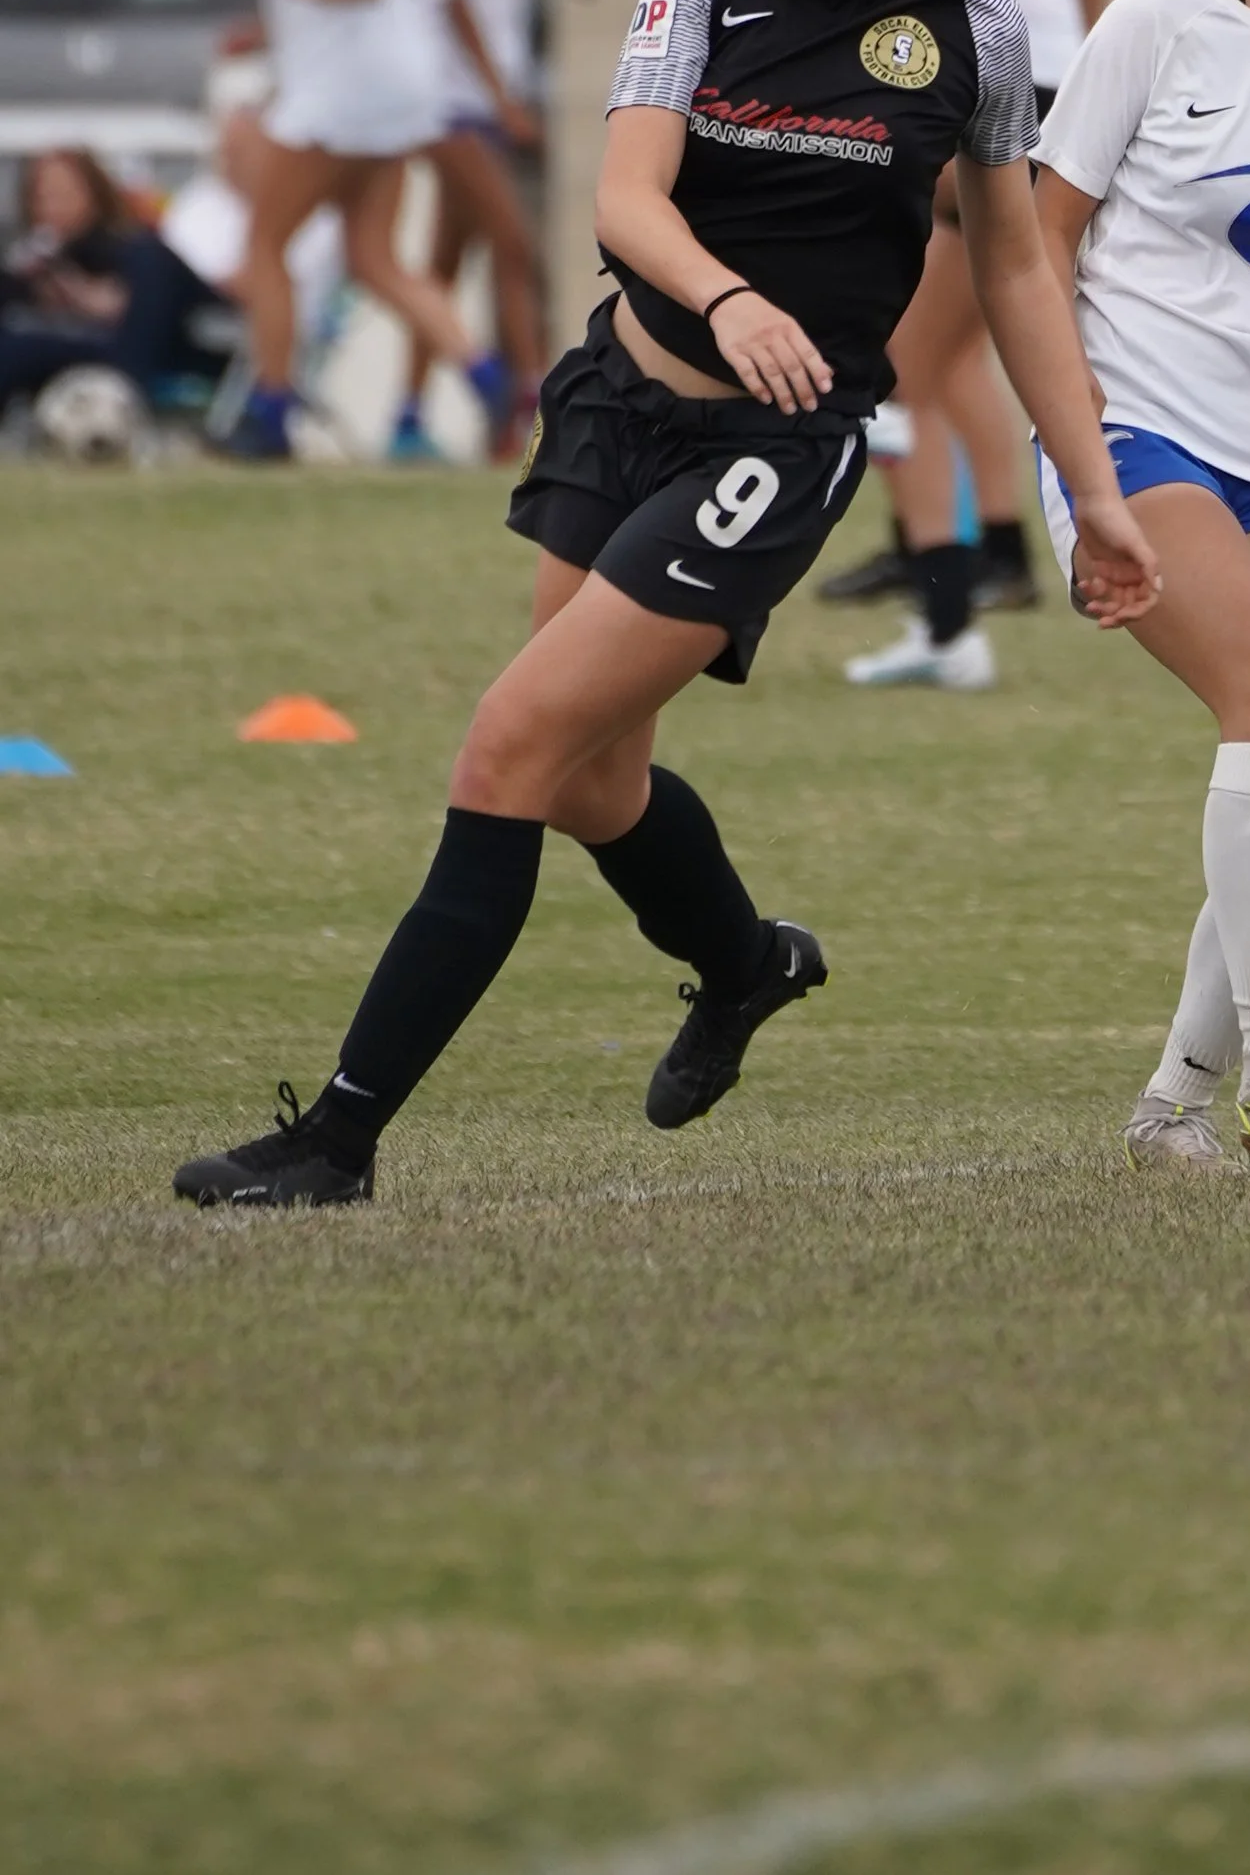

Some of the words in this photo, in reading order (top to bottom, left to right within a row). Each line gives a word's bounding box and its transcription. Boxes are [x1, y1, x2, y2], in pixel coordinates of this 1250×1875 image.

[873, 18, 909, 36] SOCAL
[912, 23, 935, 49] ELITE
[863, 51, 909, 86] FOOTBALL
[910, 68, 934, 86] CLUB
[689, 112, 894, 166] RANSMISSION
[695, 456, 780, 549] 9
